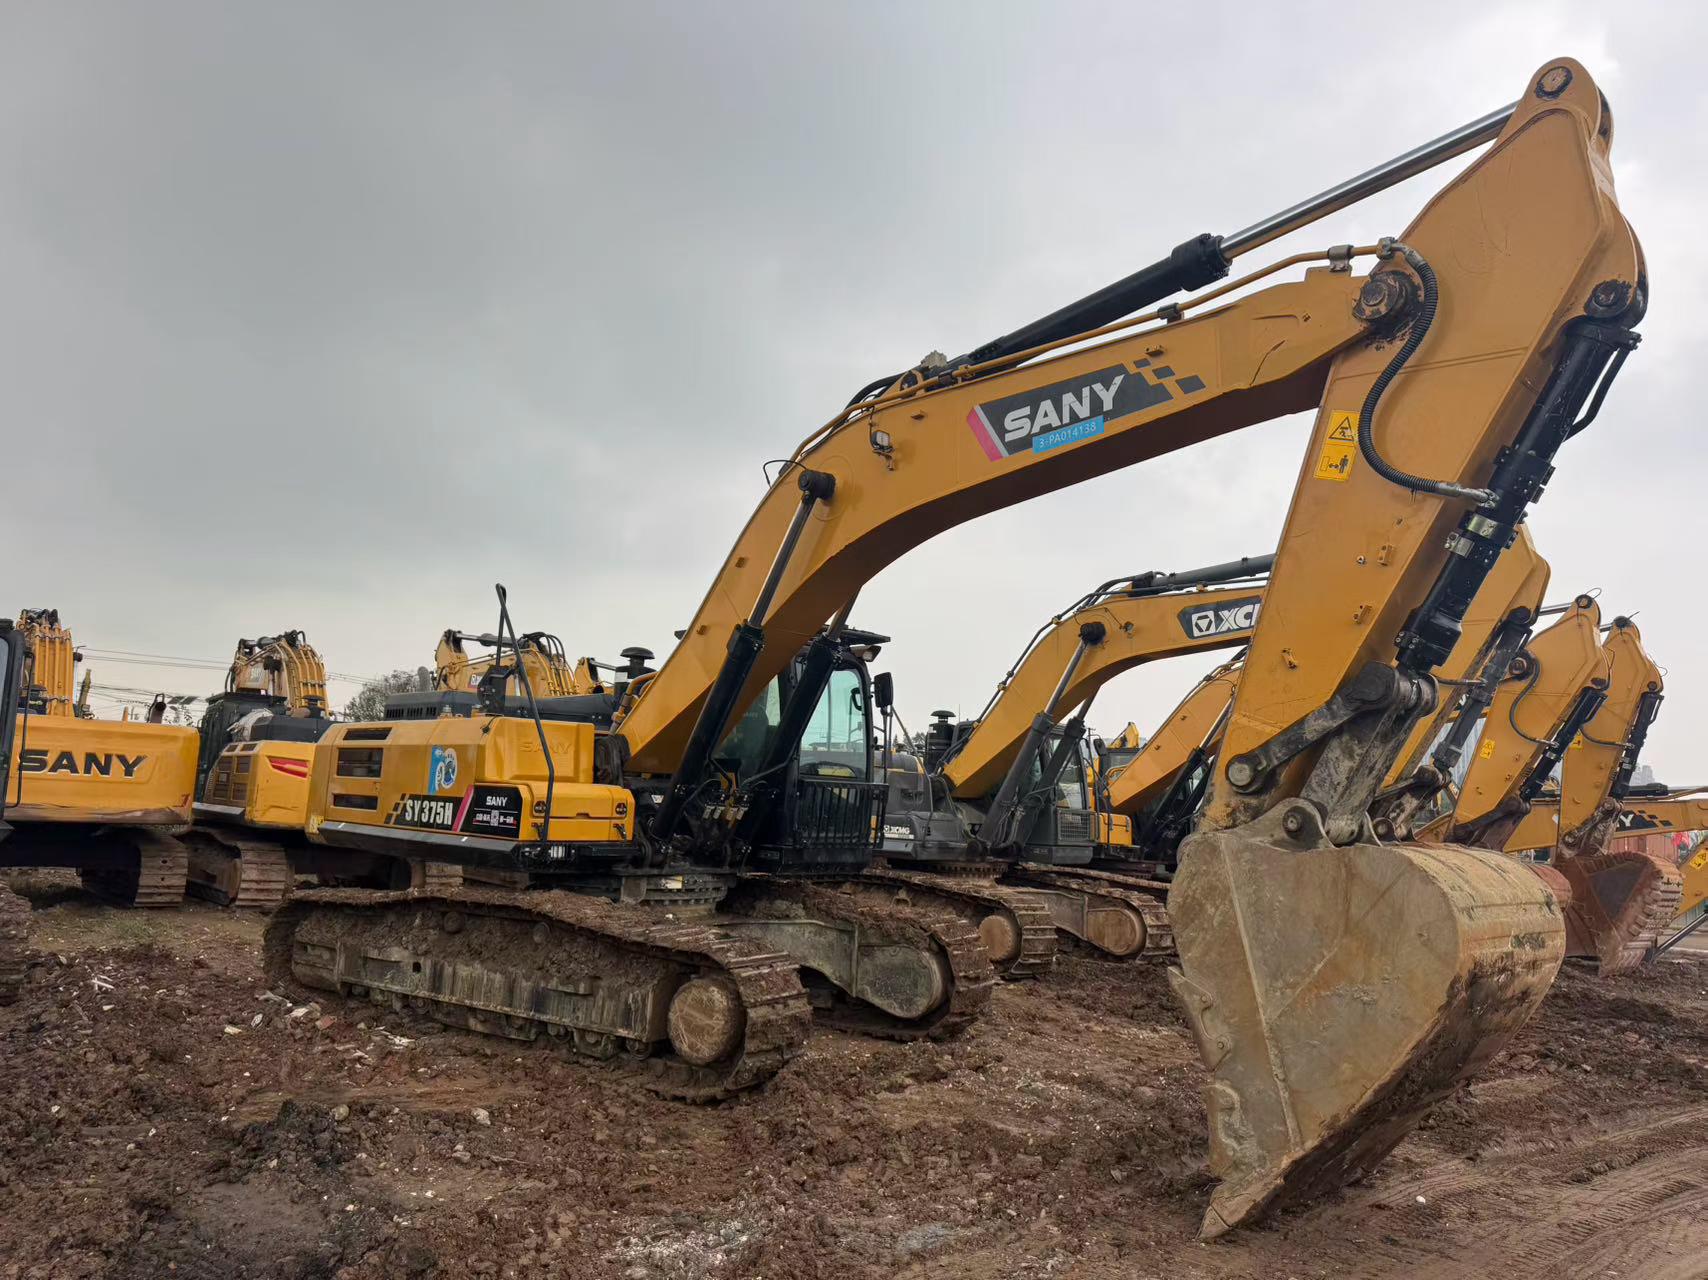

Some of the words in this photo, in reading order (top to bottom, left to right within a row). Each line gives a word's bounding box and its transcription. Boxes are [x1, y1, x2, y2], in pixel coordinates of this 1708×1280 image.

[1004, 374, 1126, 442] SANY
[18, 749, 148, 779] SANY
[486, 795, 508, 807] SANY
